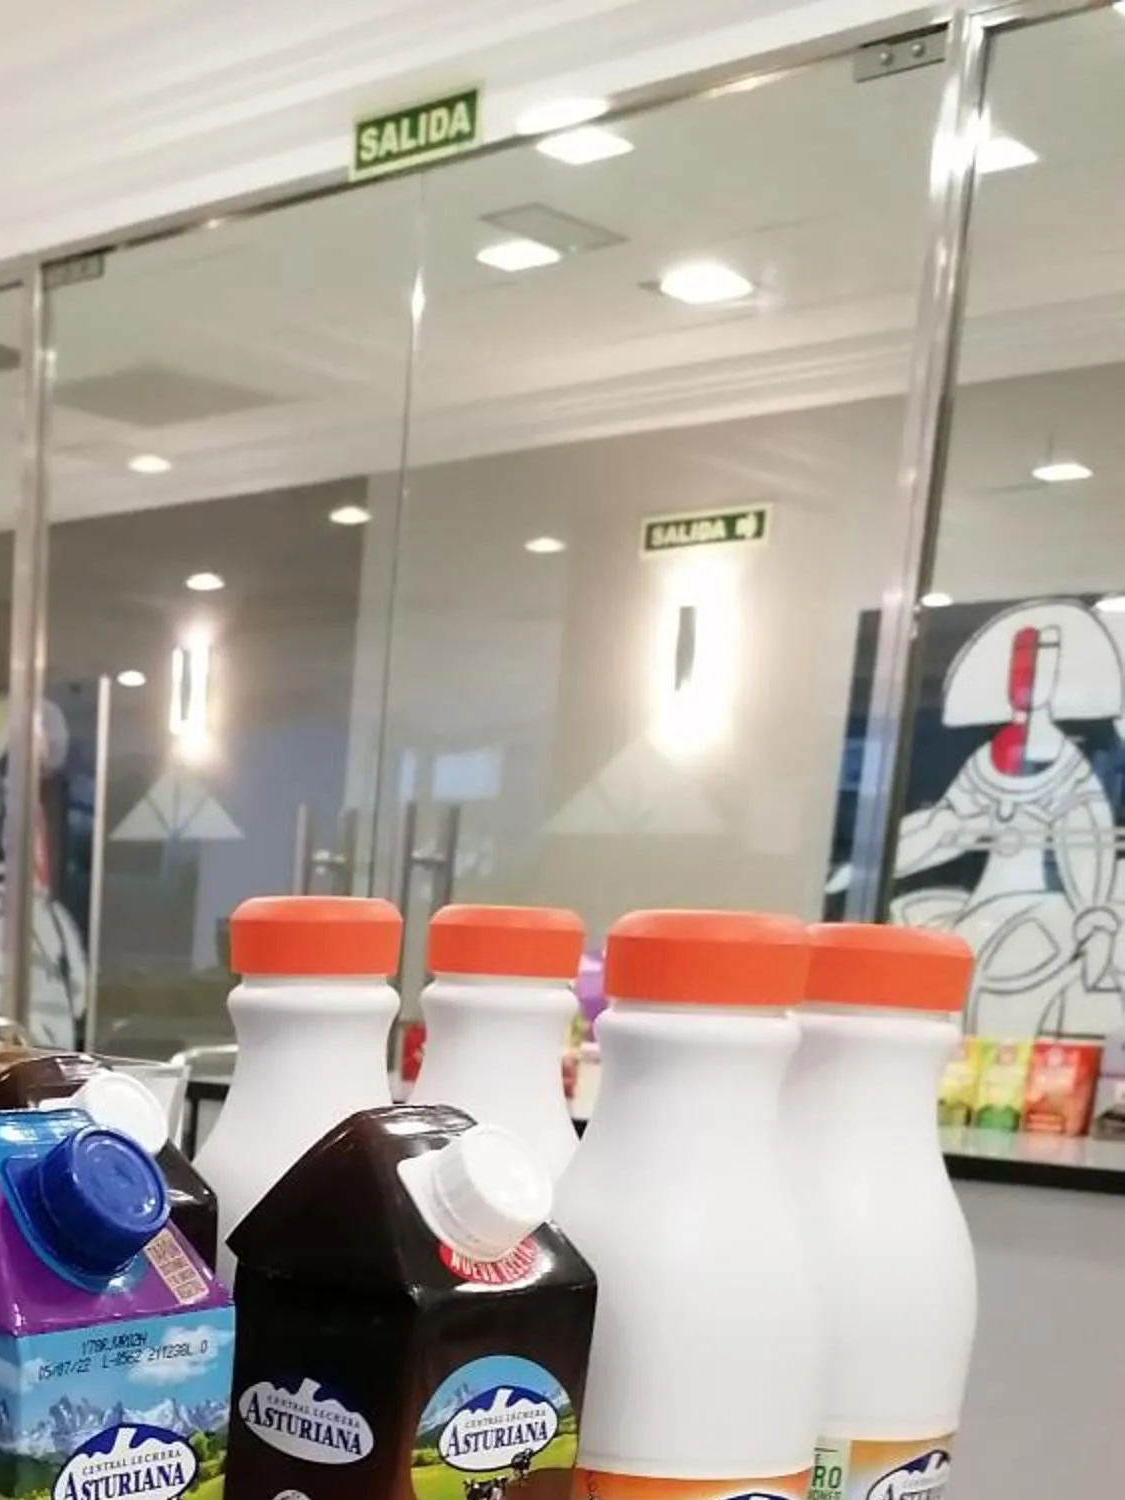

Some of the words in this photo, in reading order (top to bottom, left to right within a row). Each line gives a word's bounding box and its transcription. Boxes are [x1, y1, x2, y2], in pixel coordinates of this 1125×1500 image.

[360, 101, 472, 162] SALIDA
[650, 519, 727, 548] SALIDA
[266, 1393, 310, 1415] CENTRAL
[244, 1391, 364, 1457] ASTURIANA
[445, 1419, 549, 1458] ASTURIANA
[81, 1457, 129, 1478] CENTRAL
[130, 1447, 183, 1467] LECHERA
